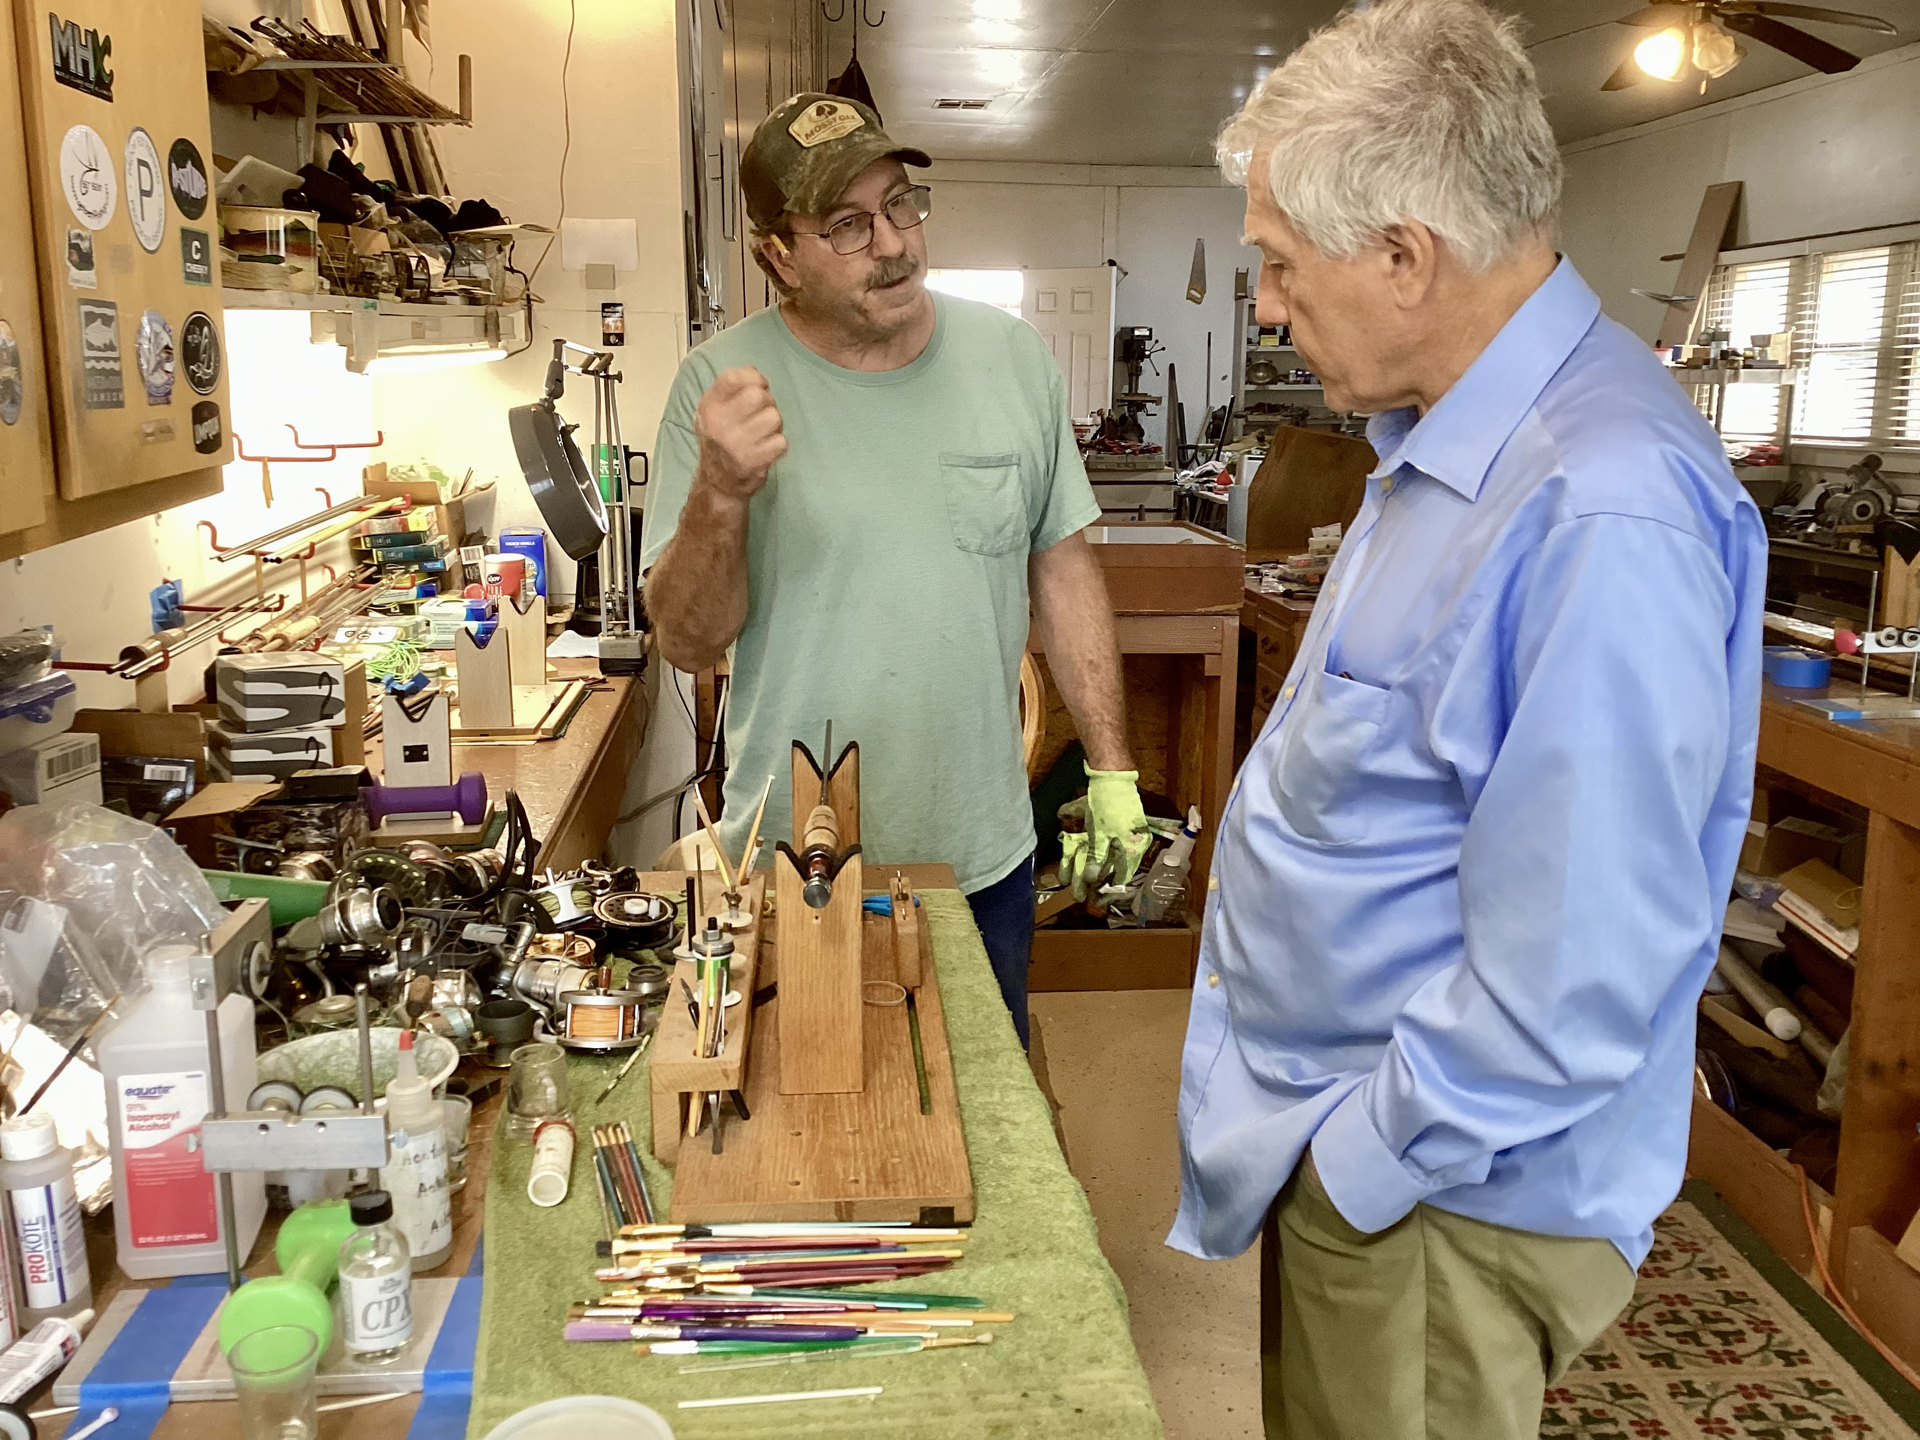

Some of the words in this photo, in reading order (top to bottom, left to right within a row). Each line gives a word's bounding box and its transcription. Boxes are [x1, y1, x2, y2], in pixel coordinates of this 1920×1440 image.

[137, 158, 155, 222] P
[191, 240, 202, 260] C
[125, 1084, 175, 1097] equate
[127, 1111, 180, 1122] Isopropyl
[128, 1122, 171, 1132] Alcohol
